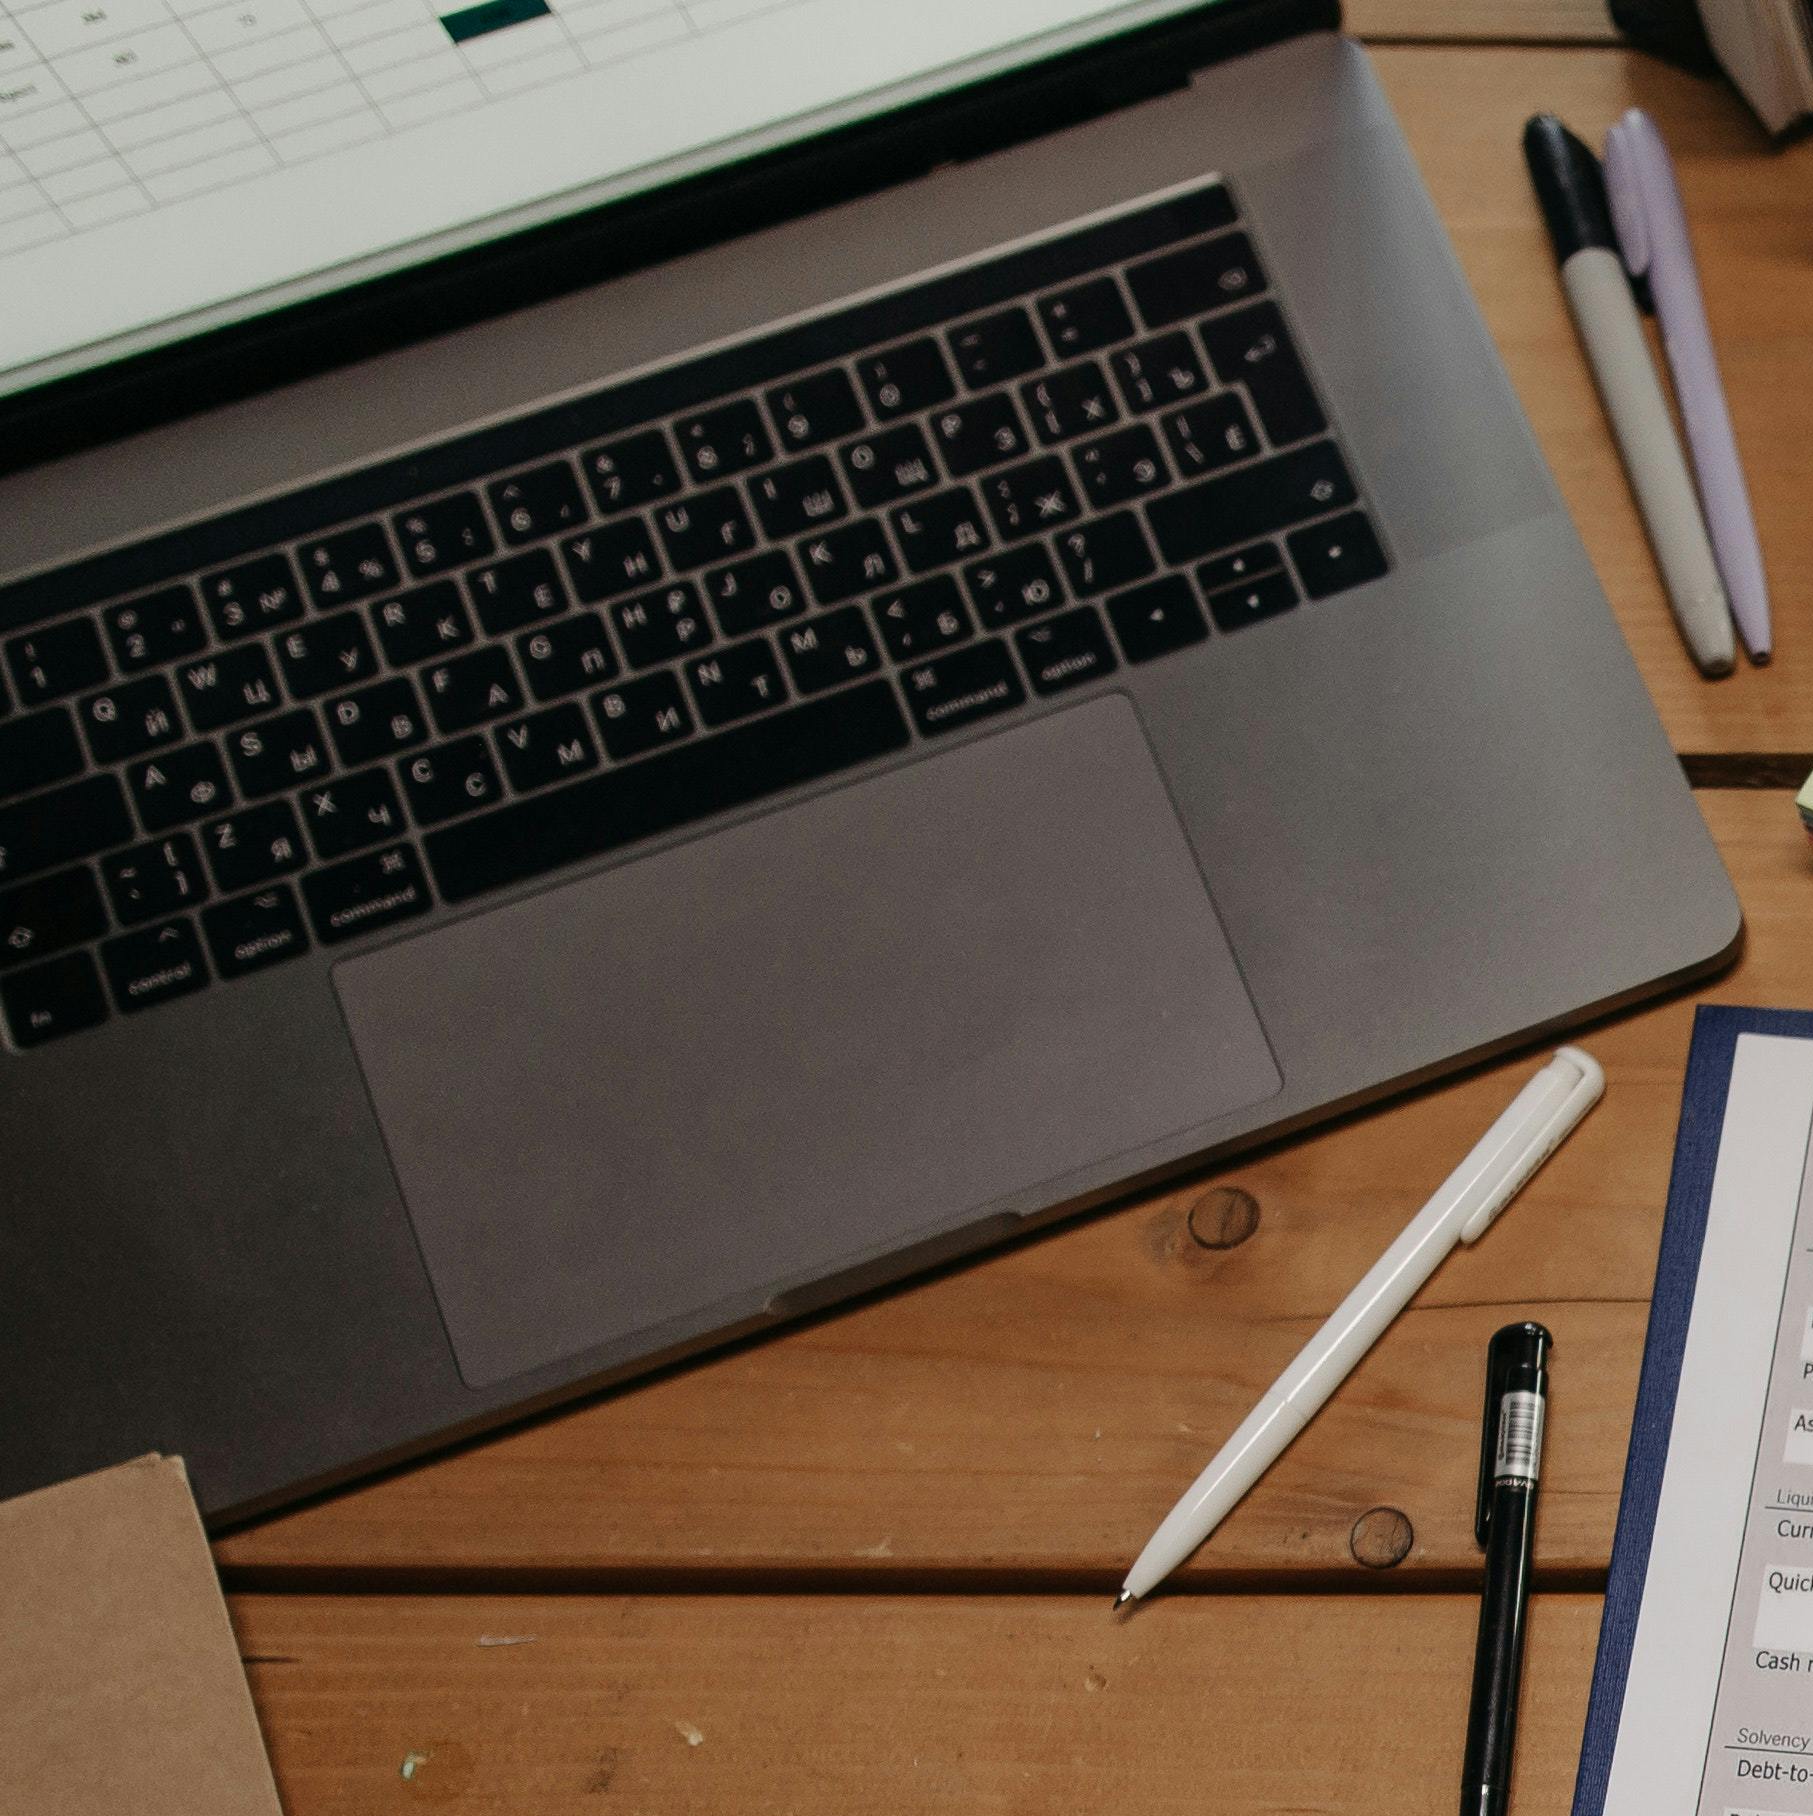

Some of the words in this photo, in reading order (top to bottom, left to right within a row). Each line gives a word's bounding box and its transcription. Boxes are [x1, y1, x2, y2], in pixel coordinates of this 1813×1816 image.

[1041, 650, 1097, 683] option
[329, 884, 417, 929] command
[234, 929, 293, 960] option
[128, 962, 193, 996] control
[1754, 1649, 1801, 1672] Cash
[1736, 1726, 1811, 1752] Solvency
